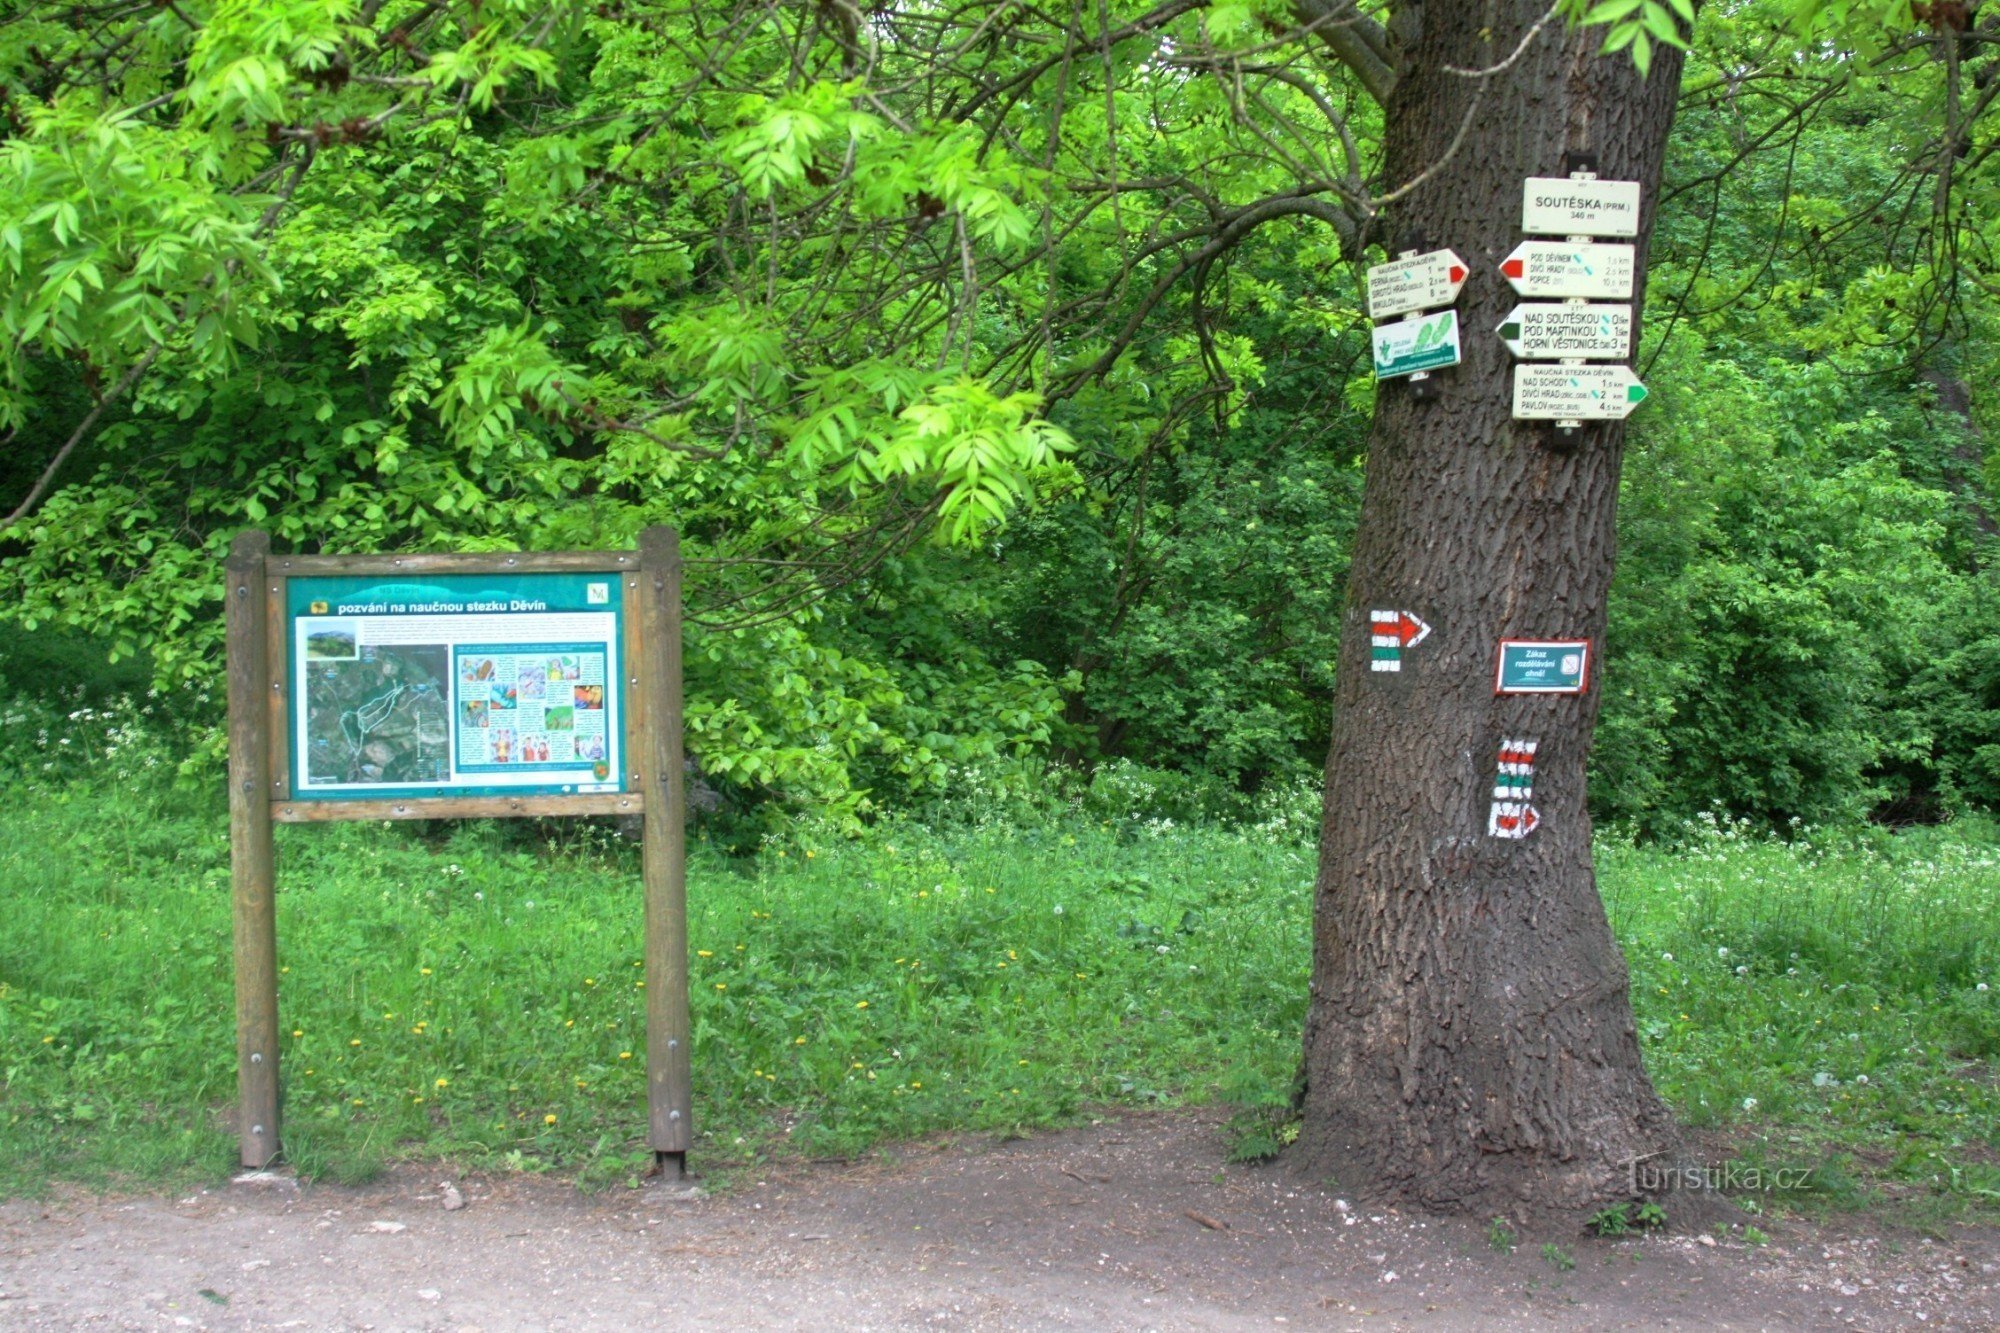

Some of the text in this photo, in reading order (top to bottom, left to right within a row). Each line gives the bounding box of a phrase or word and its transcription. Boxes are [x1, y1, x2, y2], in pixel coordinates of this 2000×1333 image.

[1619, 256, 1629, 264] km
[1619, 267, 1629, 275] km
[1619, 278, 1629, 287] km
[1525, 313, 1543, 323] NAD
[1546, 312, 1599, 324] SOUTĚSKOU
[1524, 326, 1543, 336] POD
[1546, 326, 1596, 336] MARTINKOU
[1524, 337, 1550, 349] HORNÍ
[1552, 336, 1598, 349] VĚSTONICE
[1611, 338, 1617, 349] 3
[1523, 378, 1538, 386] NAD
[1540, 378, 1568, 387] SCHODY
[1601, 391, 1606, 399] 2
[1521, 401, 1548, 410] PAVLOV
[338, 600, 546, 616] pozvání na naučnou stezku Děvín
[1526, 650, 1547, 658] Zákaz
[1515, 659, 1555, 668] rozdělávání
